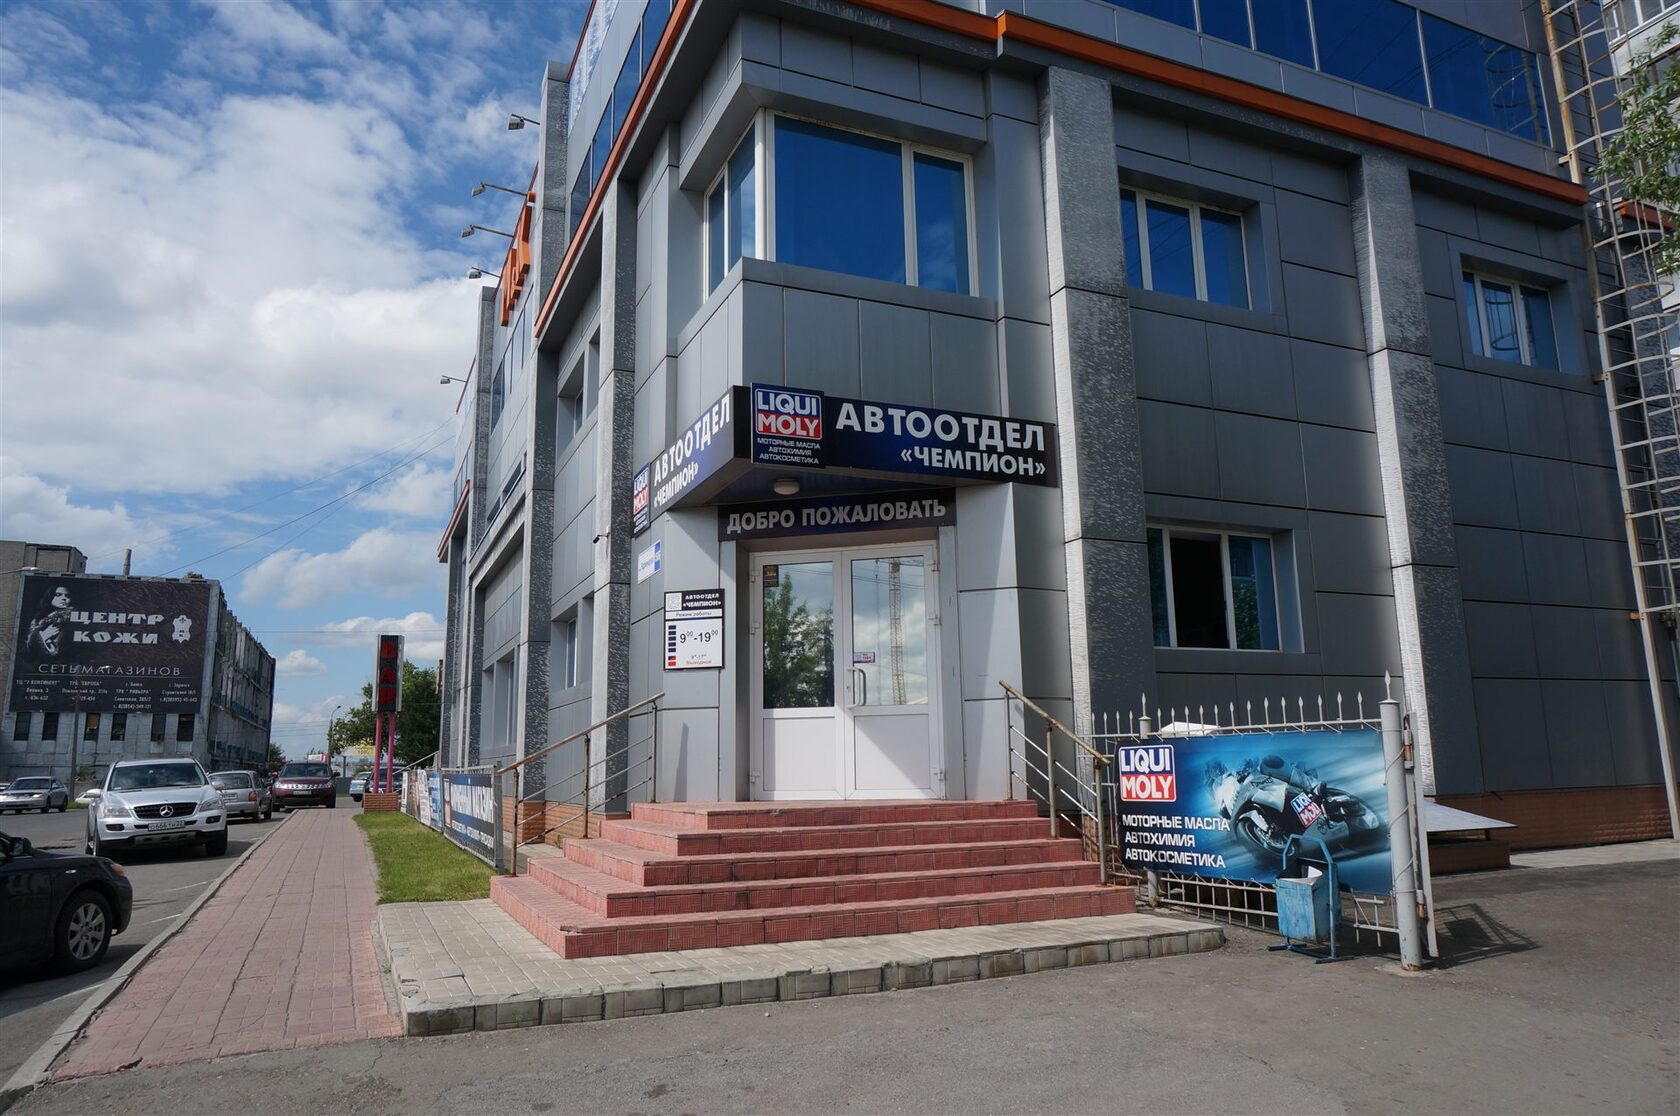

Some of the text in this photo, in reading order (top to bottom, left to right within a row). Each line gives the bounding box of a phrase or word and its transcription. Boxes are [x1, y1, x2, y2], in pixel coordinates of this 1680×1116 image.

[757, 391, 817, 416] LIQUI
[757, 413, 819, 437] MOLY
[835, 402, 1045, 452] АВТООТДЕЛ
[654, 393, 730, 487] АВТООТДЕЛ
[757, 437, 821, 450] МОТОРНЫЕ МАСЛА
[768, 446, 812, 456] АВТОХИМИЯ
[759, 452, 819, 465] АВТОКОСМЕТИКА
[900, 445, 1046, 476] «ЧЕМПИОН»
[653, 461, 699, 508] «ЧЕМПИОН»
[726, 499, 947, 534] ДОБРО ПОЖАЛОВАТЬ
[69, 611, 165, 625] ЦЕНТР
[73, 630, 159, 645] КОЖИ
[38, 663, 181, 676] СЕТЬ МАГАЗИНОВ
[1120, 748, 1171, 774] LIQUI
[1121, 775, 1173, 799] MOLY
[1122, 814, 1231, 831] МОТОРНЫЕ МАСЛА
[1125, 831, 1196, 848] АВТОХИМИЯ
[1125, 847, 1226, 869] АВТОКОСМЕТИКА
